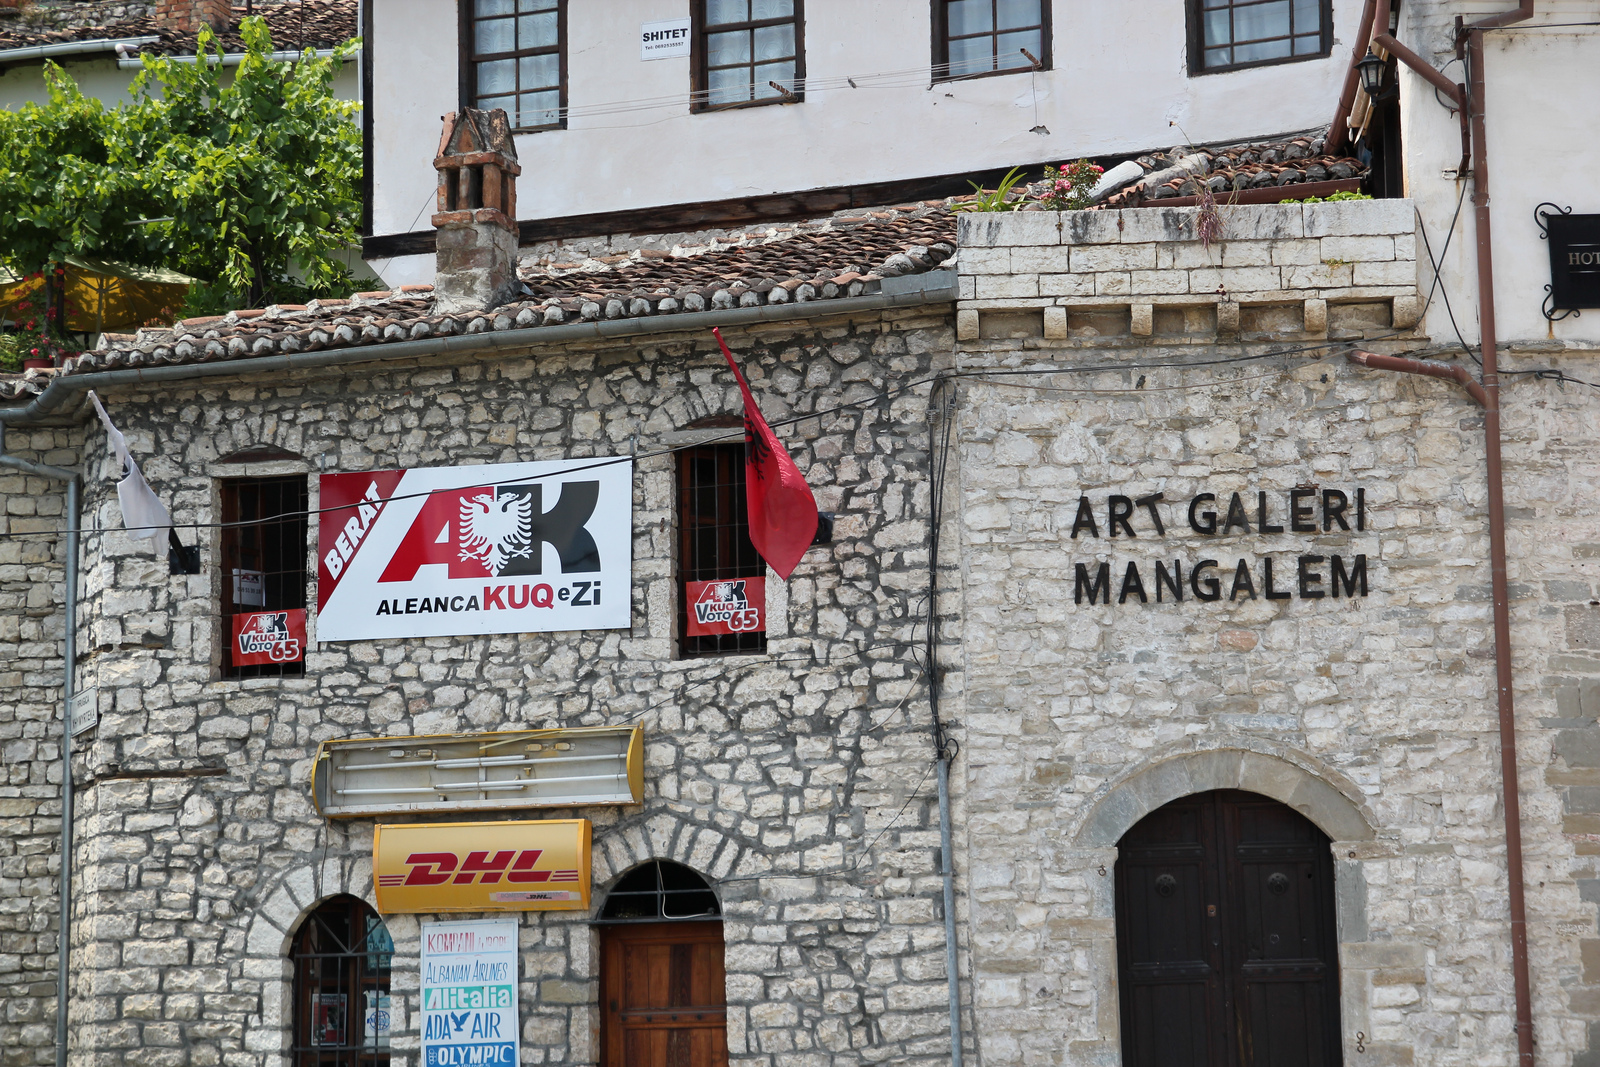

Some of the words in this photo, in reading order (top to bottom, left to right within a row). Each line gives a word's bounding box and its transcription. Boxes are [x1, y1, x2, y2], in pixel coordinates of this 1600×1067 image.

[643, 28, 688, 42] SHITET
[1070, 492, 1165, 538] ART
[1188, 488, 1365, 535] GALERI
[323, 480, 382, 581] BERAT
[1074, 554, 1368, 605] MANGALEM
[376, 595, 480, 616] ALEANCA
[730, 611, 758, 629] 65
[271, 641, 298, 659] 65
[403, 850, 553, 886] DHL
[427, 932, 475, 953] KOMPANI
[426, 962, 471, 984] ALBANIAN
[472, 960, 508, 982] AIRLINES
[426, 986, 511, 1009] Alitalia
[425, 1014, 452, 1040] ADA
[471, 1012, 501, 1039] AIR
[438, 1045, 513, 1065] OLYMPIC
